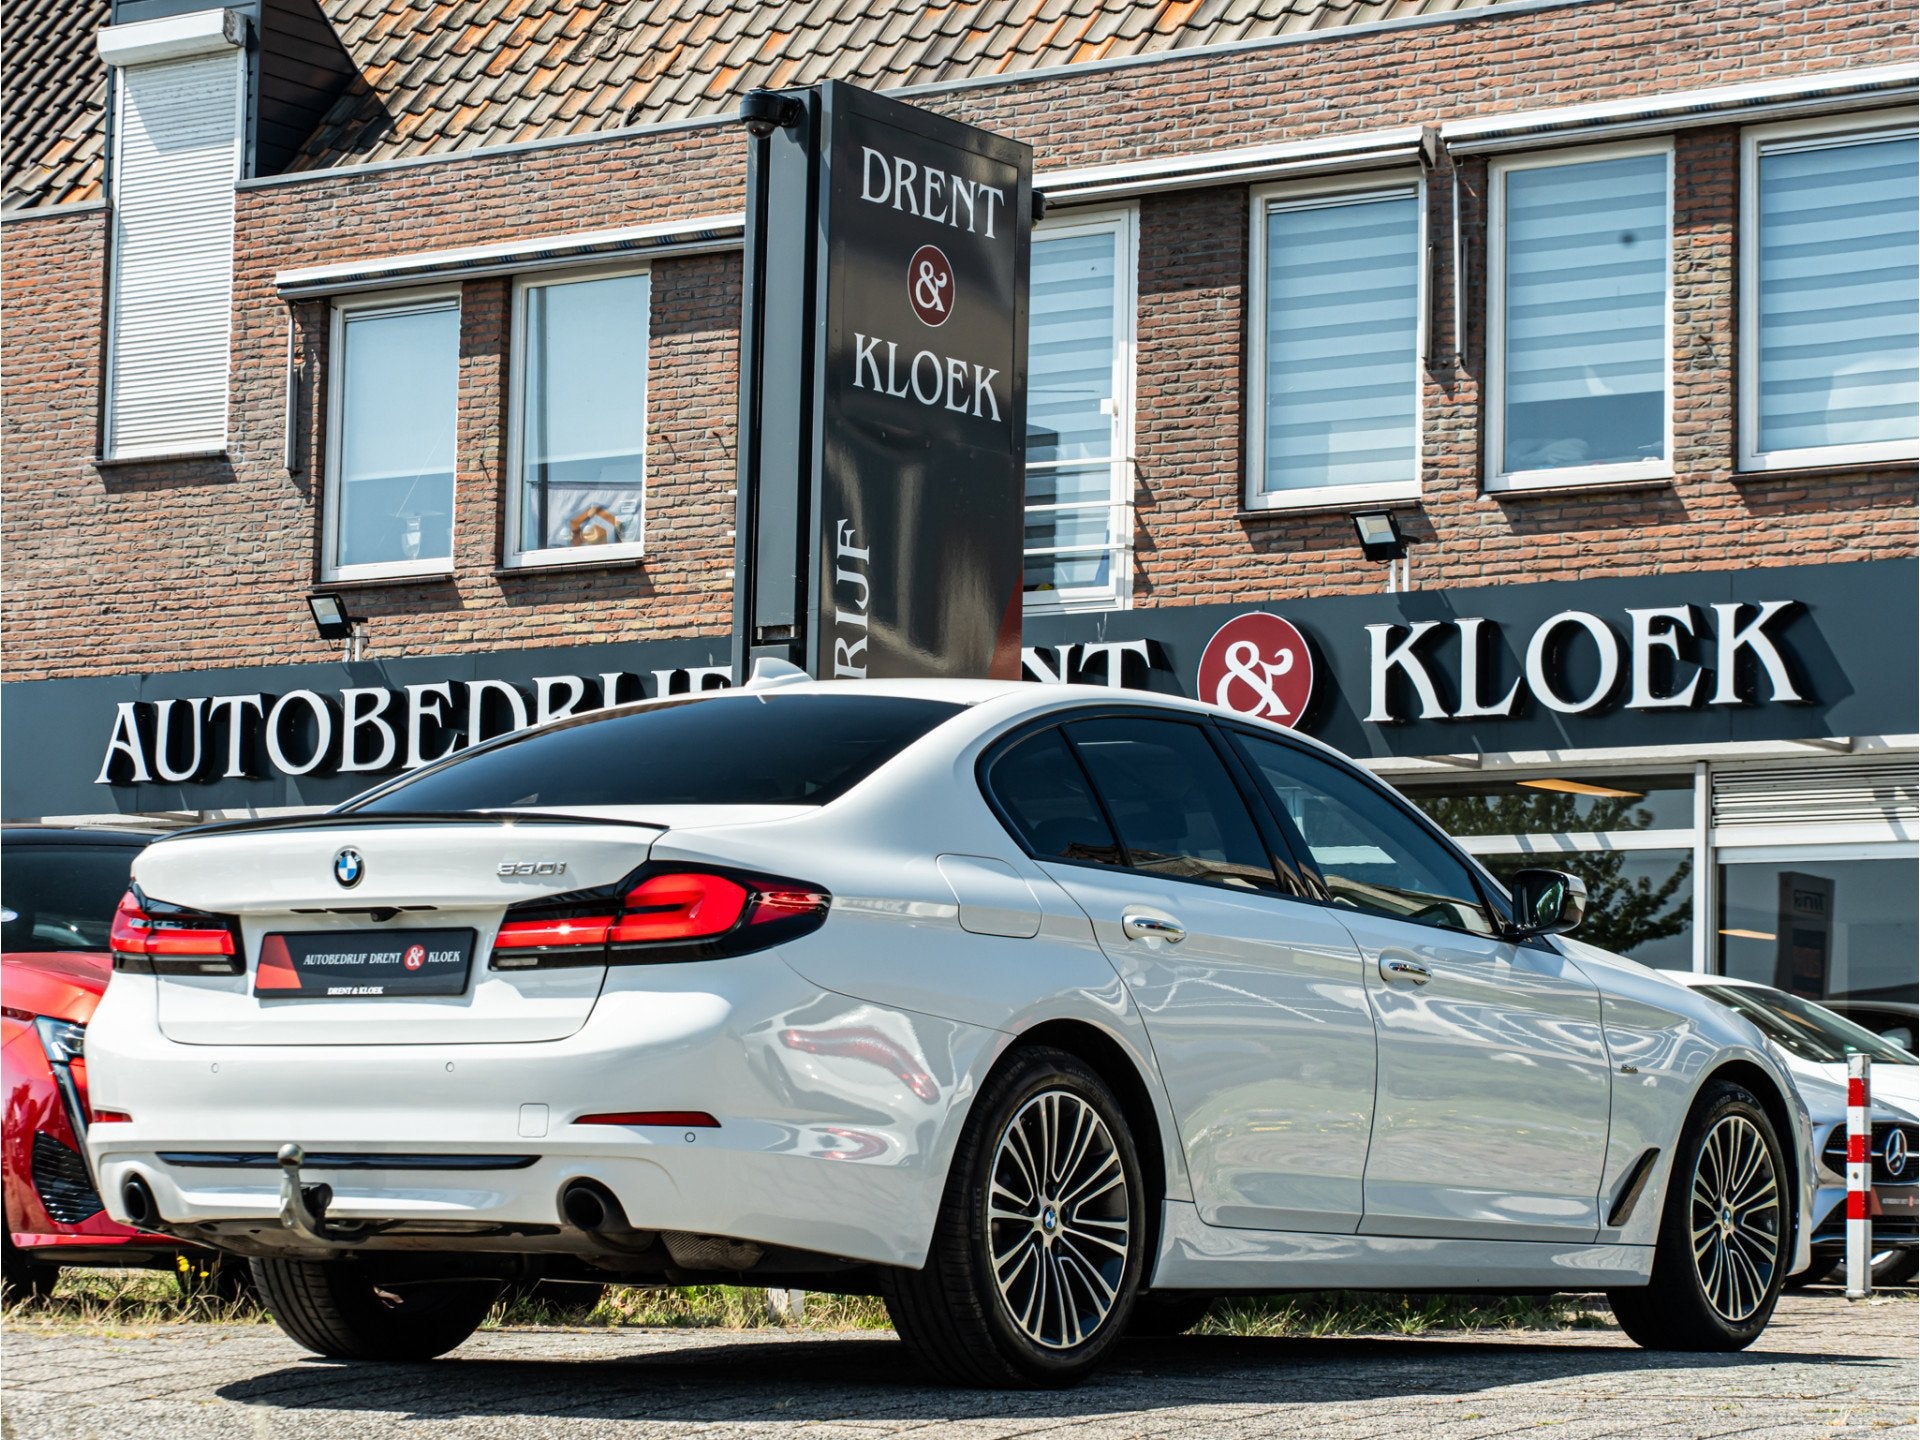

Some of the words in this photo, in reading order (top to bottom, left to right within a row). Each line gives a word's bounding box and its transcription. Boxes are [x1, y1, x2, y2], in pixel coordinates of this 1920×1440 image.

[860, 146, 1005, 239] DRENT
[915, 260, 948, 312] &
[852, 332, 1002, 422] KLOEK
[95, 666, 732, 784] AUTOBEDR
[1216, 640, 1294, 716] &
[1363, 599, 1804, 723] KLOEK
[496, 861, 567, 876] 530i
[303, 953, 367, 966] AUTOBEDRIJF
[369, 952, 401, 964] DRENT
[407, 947, 423, 967] &
[428, 951, 460, 963] KLOEK
[327, 987, 350, 995] DRENT
[359, 986, 384, 994] KLOEK
